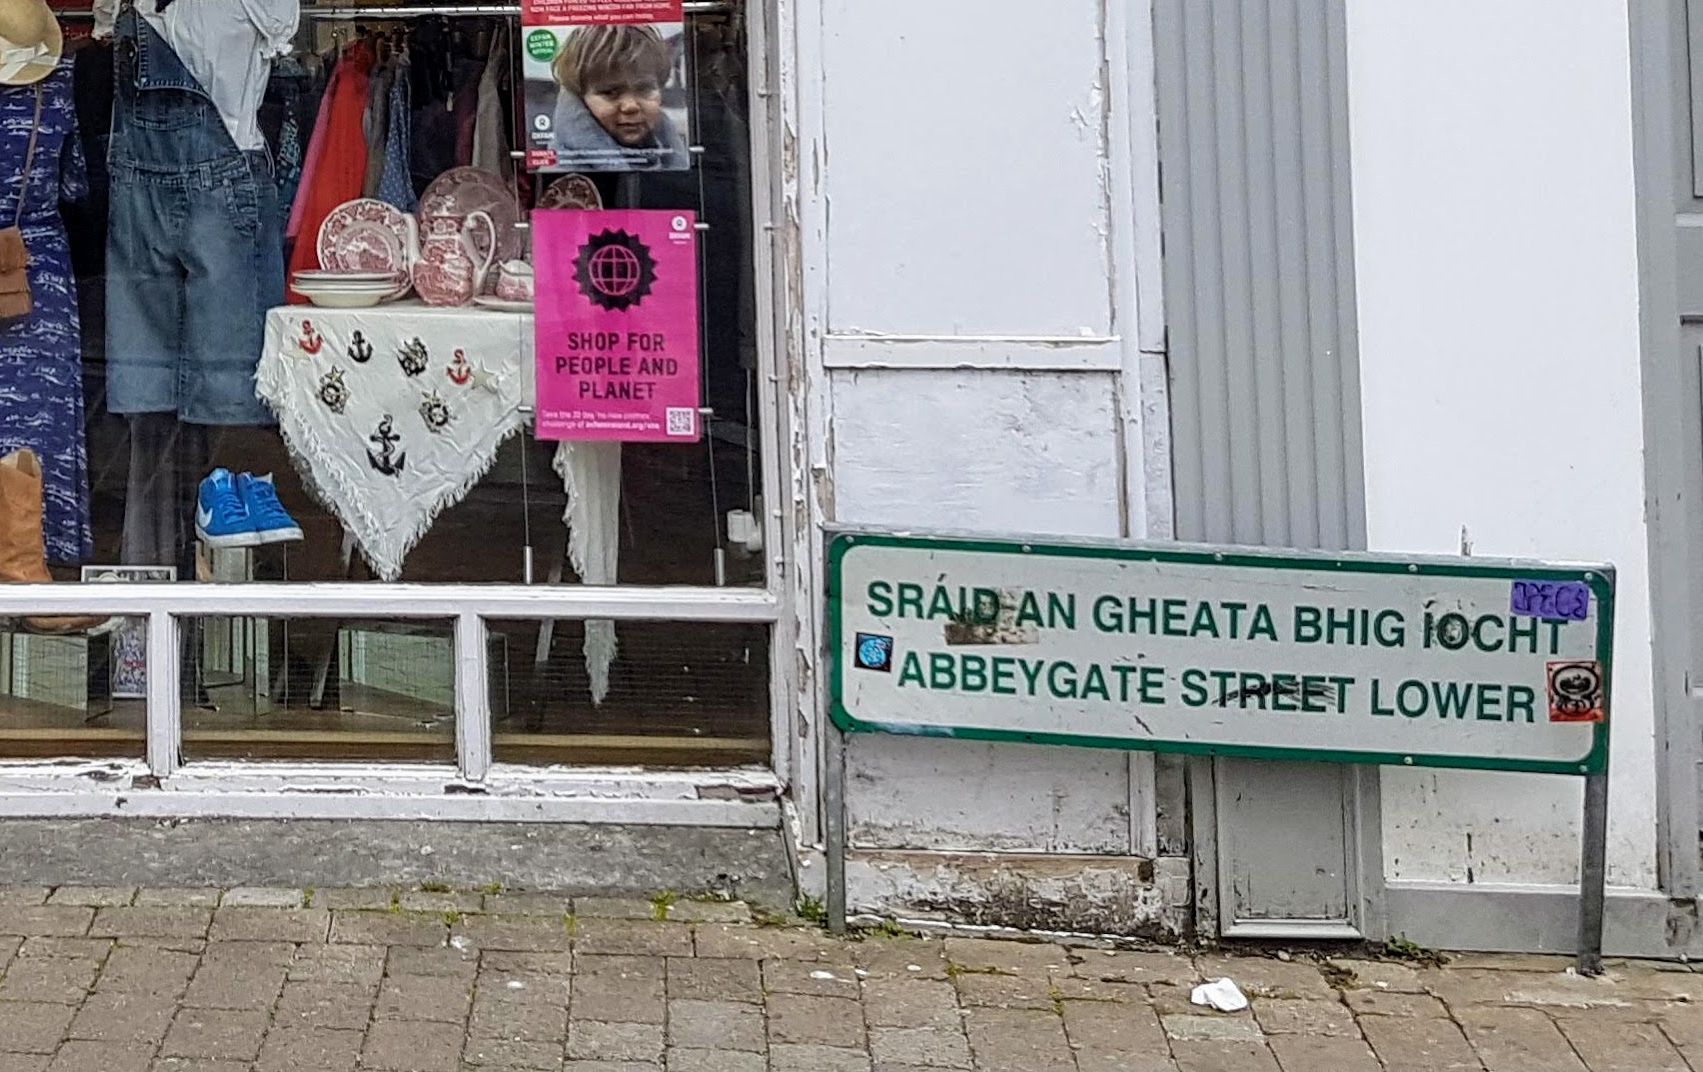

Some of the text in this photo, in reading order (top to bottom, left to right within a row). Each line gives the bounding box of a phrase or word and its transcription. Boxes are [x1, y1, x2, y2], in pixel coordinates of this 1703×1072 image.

[568, 332, 664, 352] SHOP FOR
[556, 357, 678, 376] PEOPLE AND
[579, 381, 657, 400] PLANET
[867, 573, 1000, 625] SRÁID
[1015, 590, 1076, 630] AN
[1093, 594, 1278, 641] GHEATA
[1295, 605, 1405, 648] BHIG
[897, 650, 1535, 724] ABBEYGATE STREET LOWER
